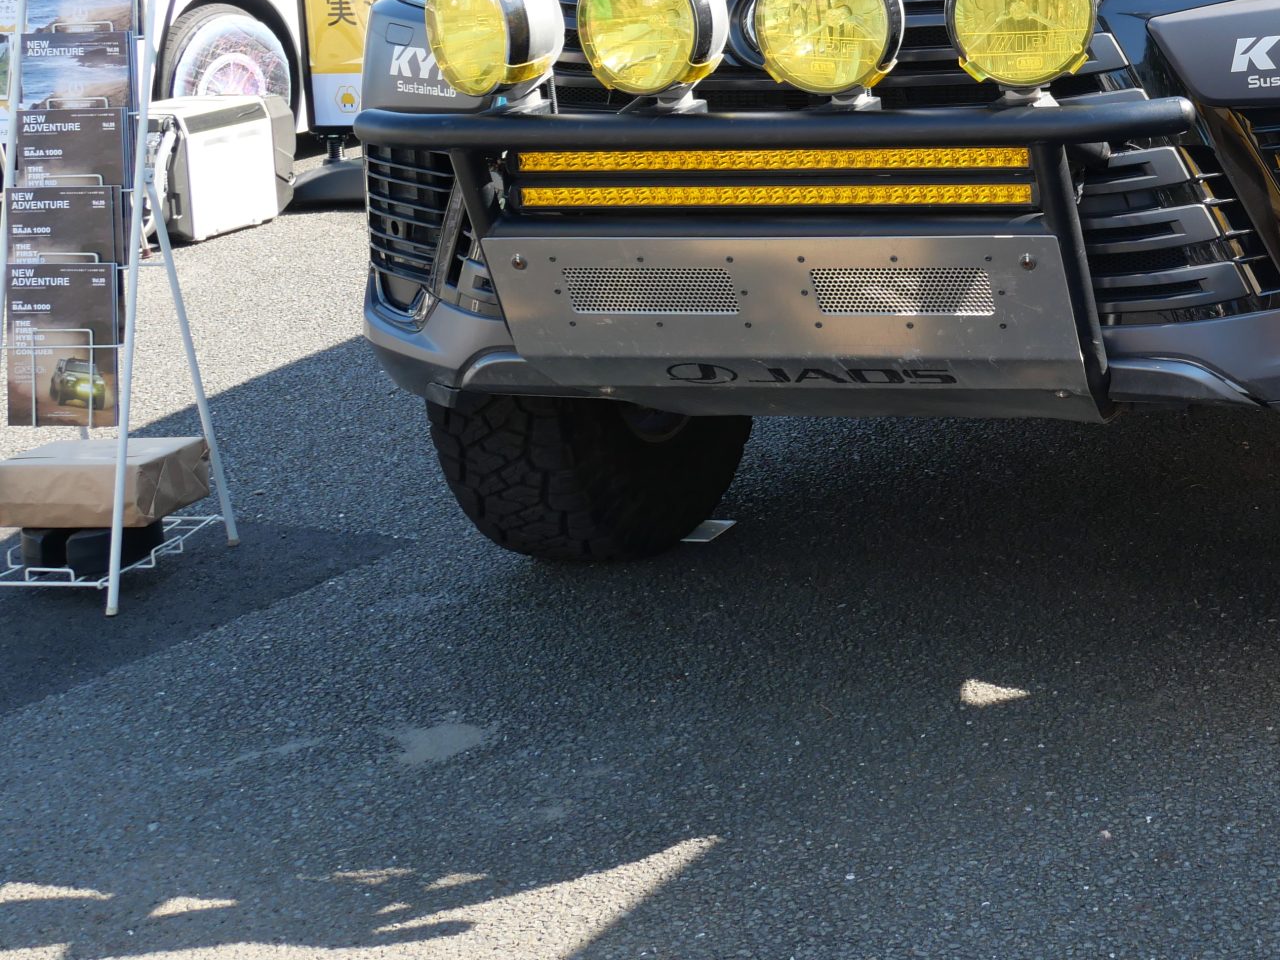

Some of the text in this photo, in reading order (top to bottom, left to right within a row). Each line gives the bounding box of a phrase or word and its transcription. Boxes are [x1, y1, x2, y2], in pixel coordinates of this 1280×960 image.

[27, 40, 49, 49] NEW
[27, 48, 85, 56] ADVENTURE
[389, 45, 446, 81] KY
[397, 80, 457, 98] SustainaLub
[23, 115, 46, 123] NEW
[23, 123, 81, 132] ADVENTURE
[12, 192, 34, 200] NEW
[12, 200, 70, 209] ADVENTURE
[12, 269, 34, 277] NEW
[12, 277, 70, 286] ADVENTURE
[749, 367, 957, 384] JAOS
